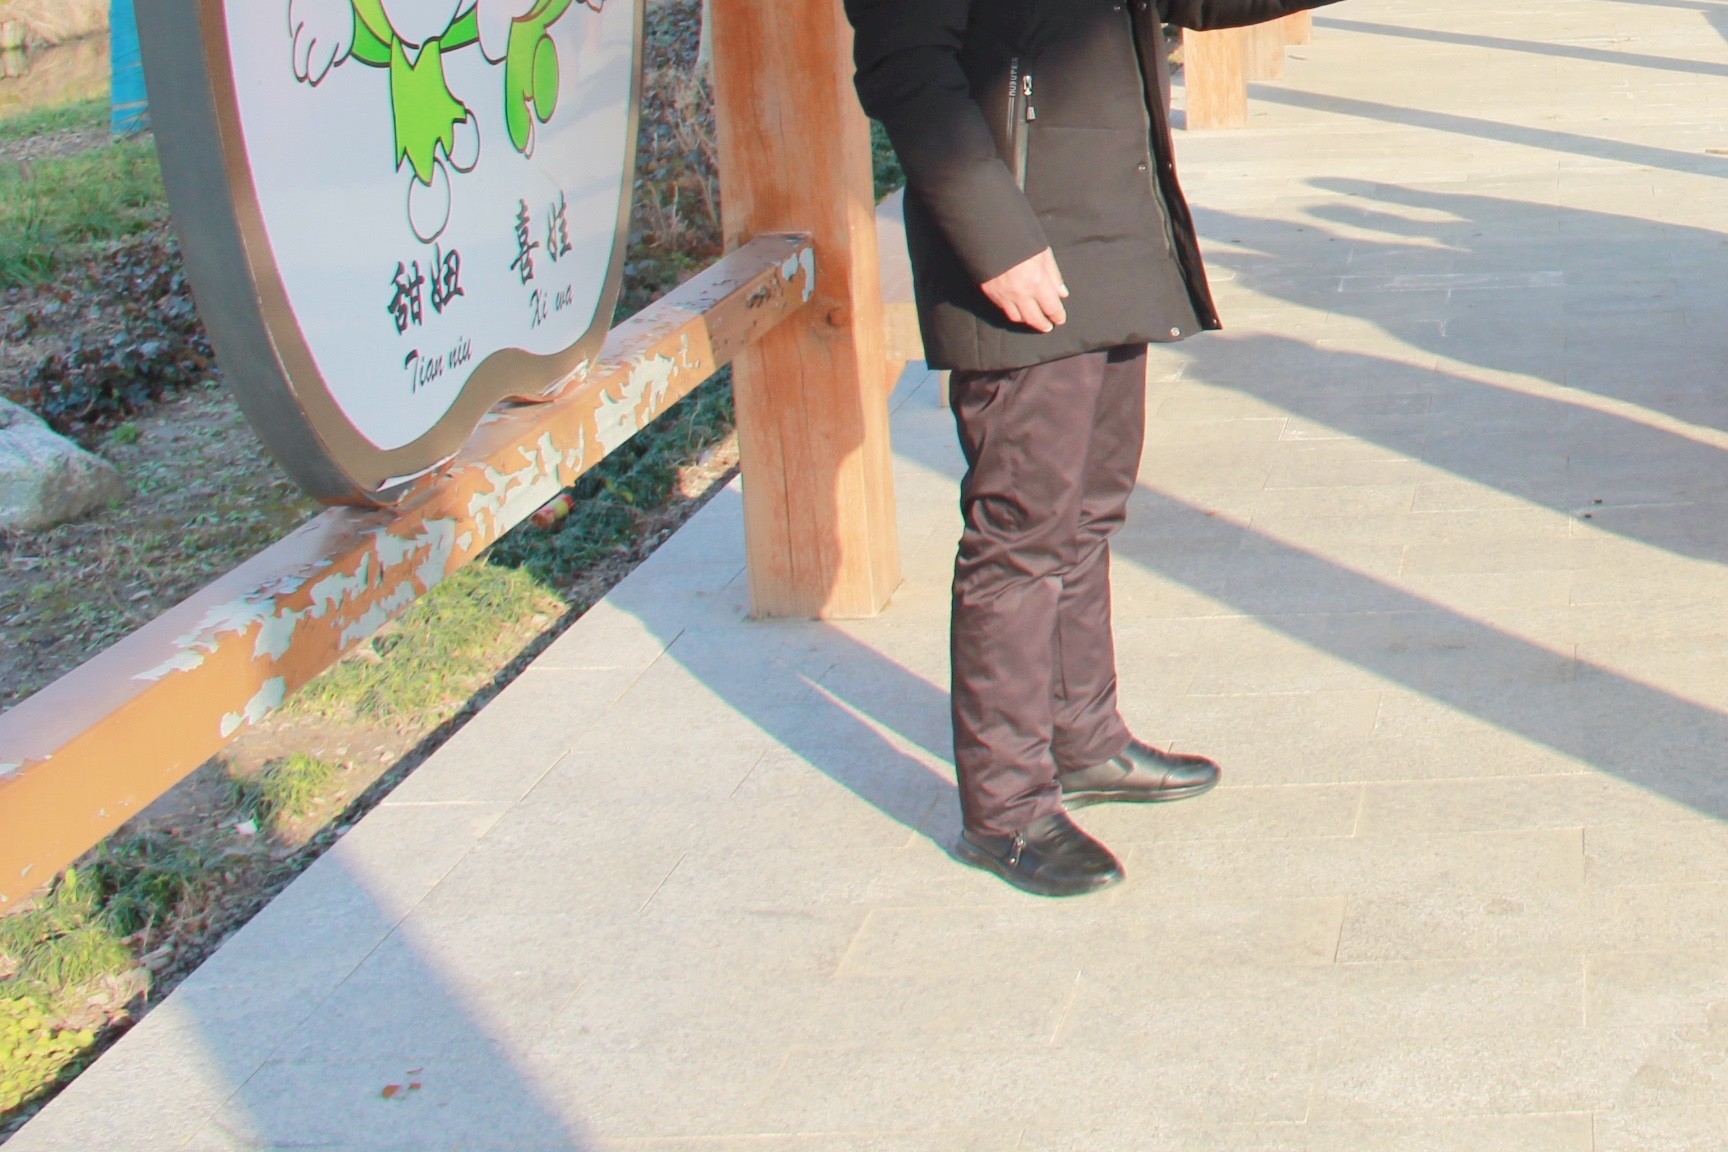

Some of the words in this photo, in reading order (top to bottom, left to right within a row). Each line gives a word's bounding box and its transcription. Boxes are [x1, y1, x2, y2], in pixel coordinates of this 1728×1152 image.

[529, 288, 548, 330] Xi
[404, 348, 443, 394] Tian
[449, 336, 472, 368] niu
